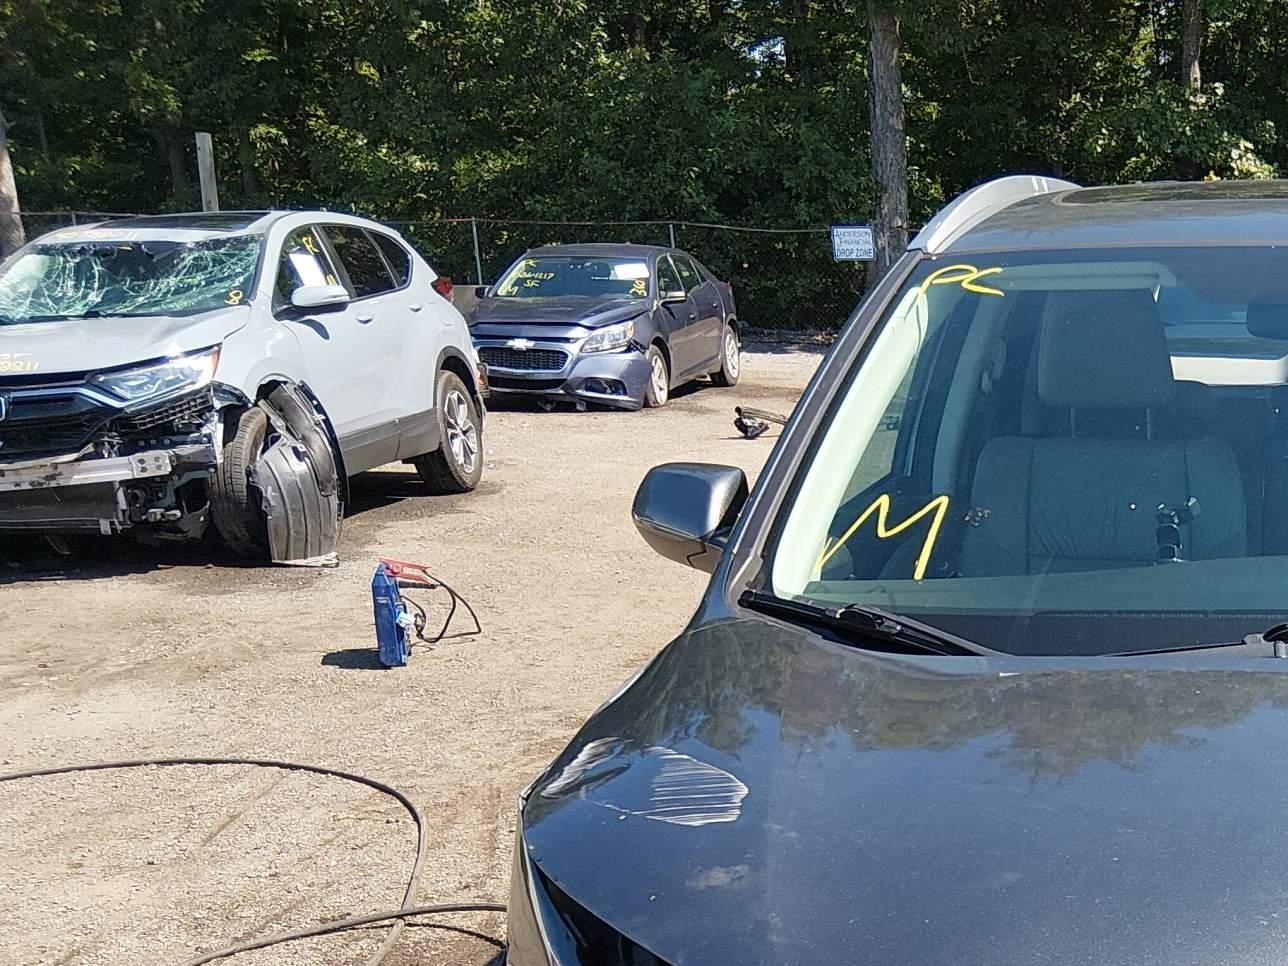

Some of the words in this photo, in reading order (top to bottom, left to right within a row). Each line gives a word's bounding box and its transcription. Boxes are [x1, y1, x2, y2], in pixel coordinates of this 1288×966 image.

[835, 229, 871, 238] ANDERSON
[839, 238, 873, 247] FINANCIAL
[836, 248, 855, 258] DROP
[855, 248, 873, 258] ZONE
[812, 493, 949, 581] M
